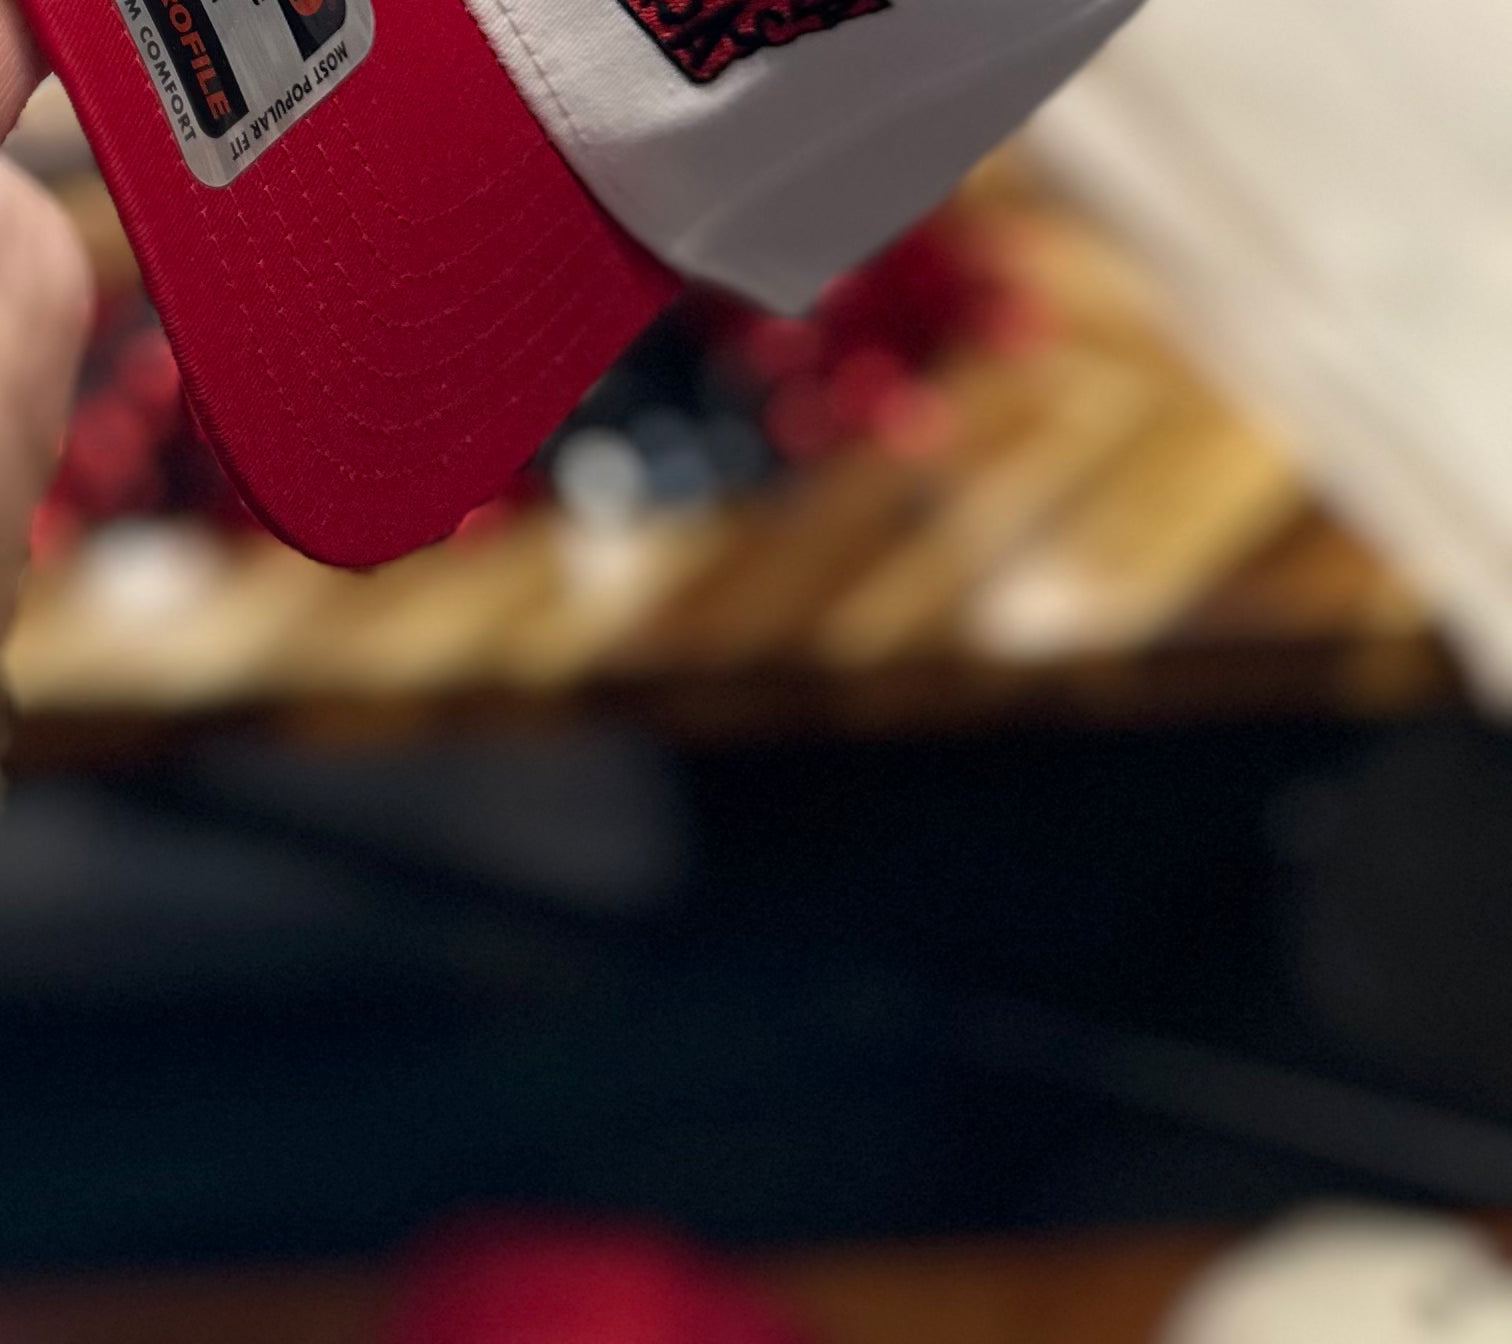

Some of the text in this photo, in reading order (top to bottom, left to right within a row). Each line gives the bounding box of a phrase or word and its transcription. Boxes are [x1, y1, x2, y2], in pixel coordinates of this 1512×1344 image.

[139, 26, 197, 144] COMFORT
[230, 40, 349, 161] MOST POPULAR FIT
